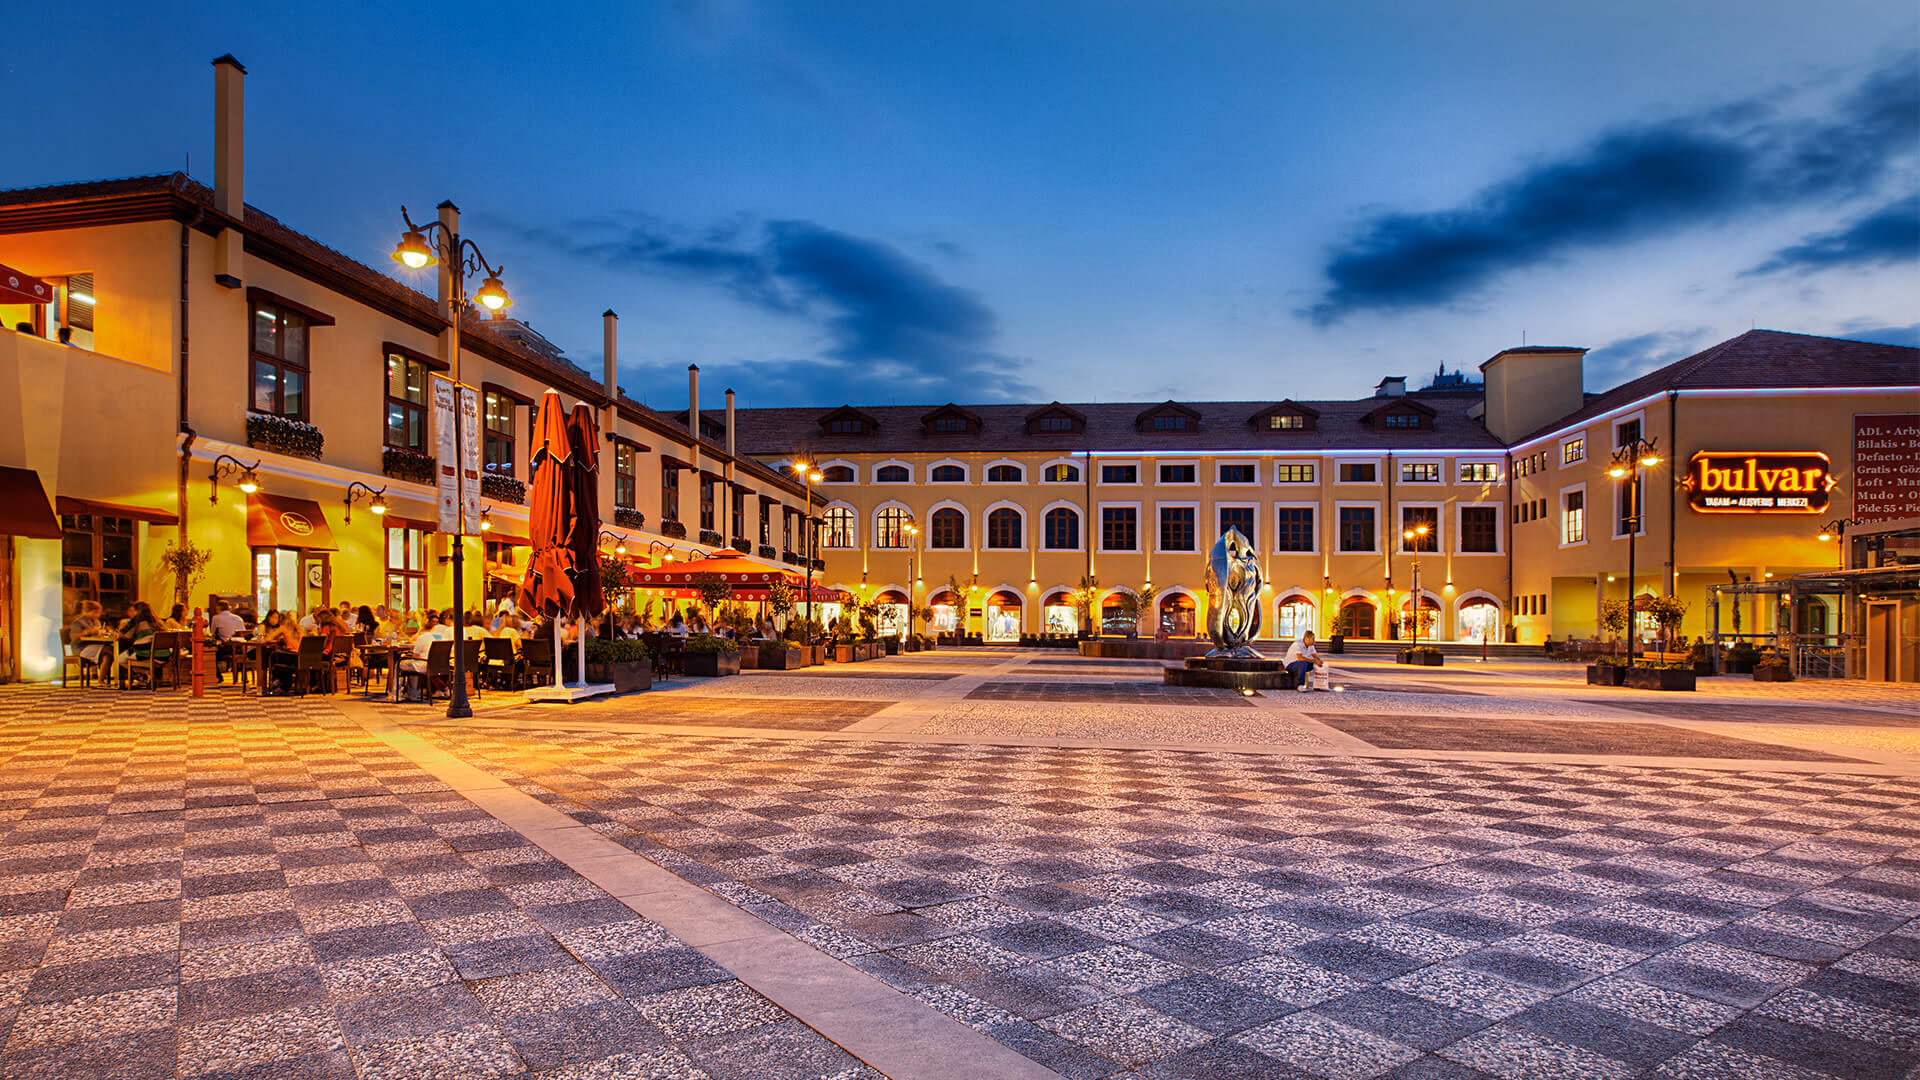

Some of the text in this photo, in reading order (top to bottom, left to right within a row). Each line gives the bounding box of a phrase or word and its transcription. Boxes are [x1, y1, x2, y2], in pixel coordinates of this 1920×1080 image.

[1857, 427, 1883, 436] ADL
[1857, 440, 1898, 449] Bilakis
[1857, 452, 1903, 461] Defacto
[1857, 465, 1891, 474] Gratis
[1698, 458, 1822, 492] bulvar
[1857, 478, 1883, 487] Loft
[1857, 490, 1920, 500] Mudo O
[1857, 503, 1881, 513] Pide
[1883, 504, 1896, 513] 55
